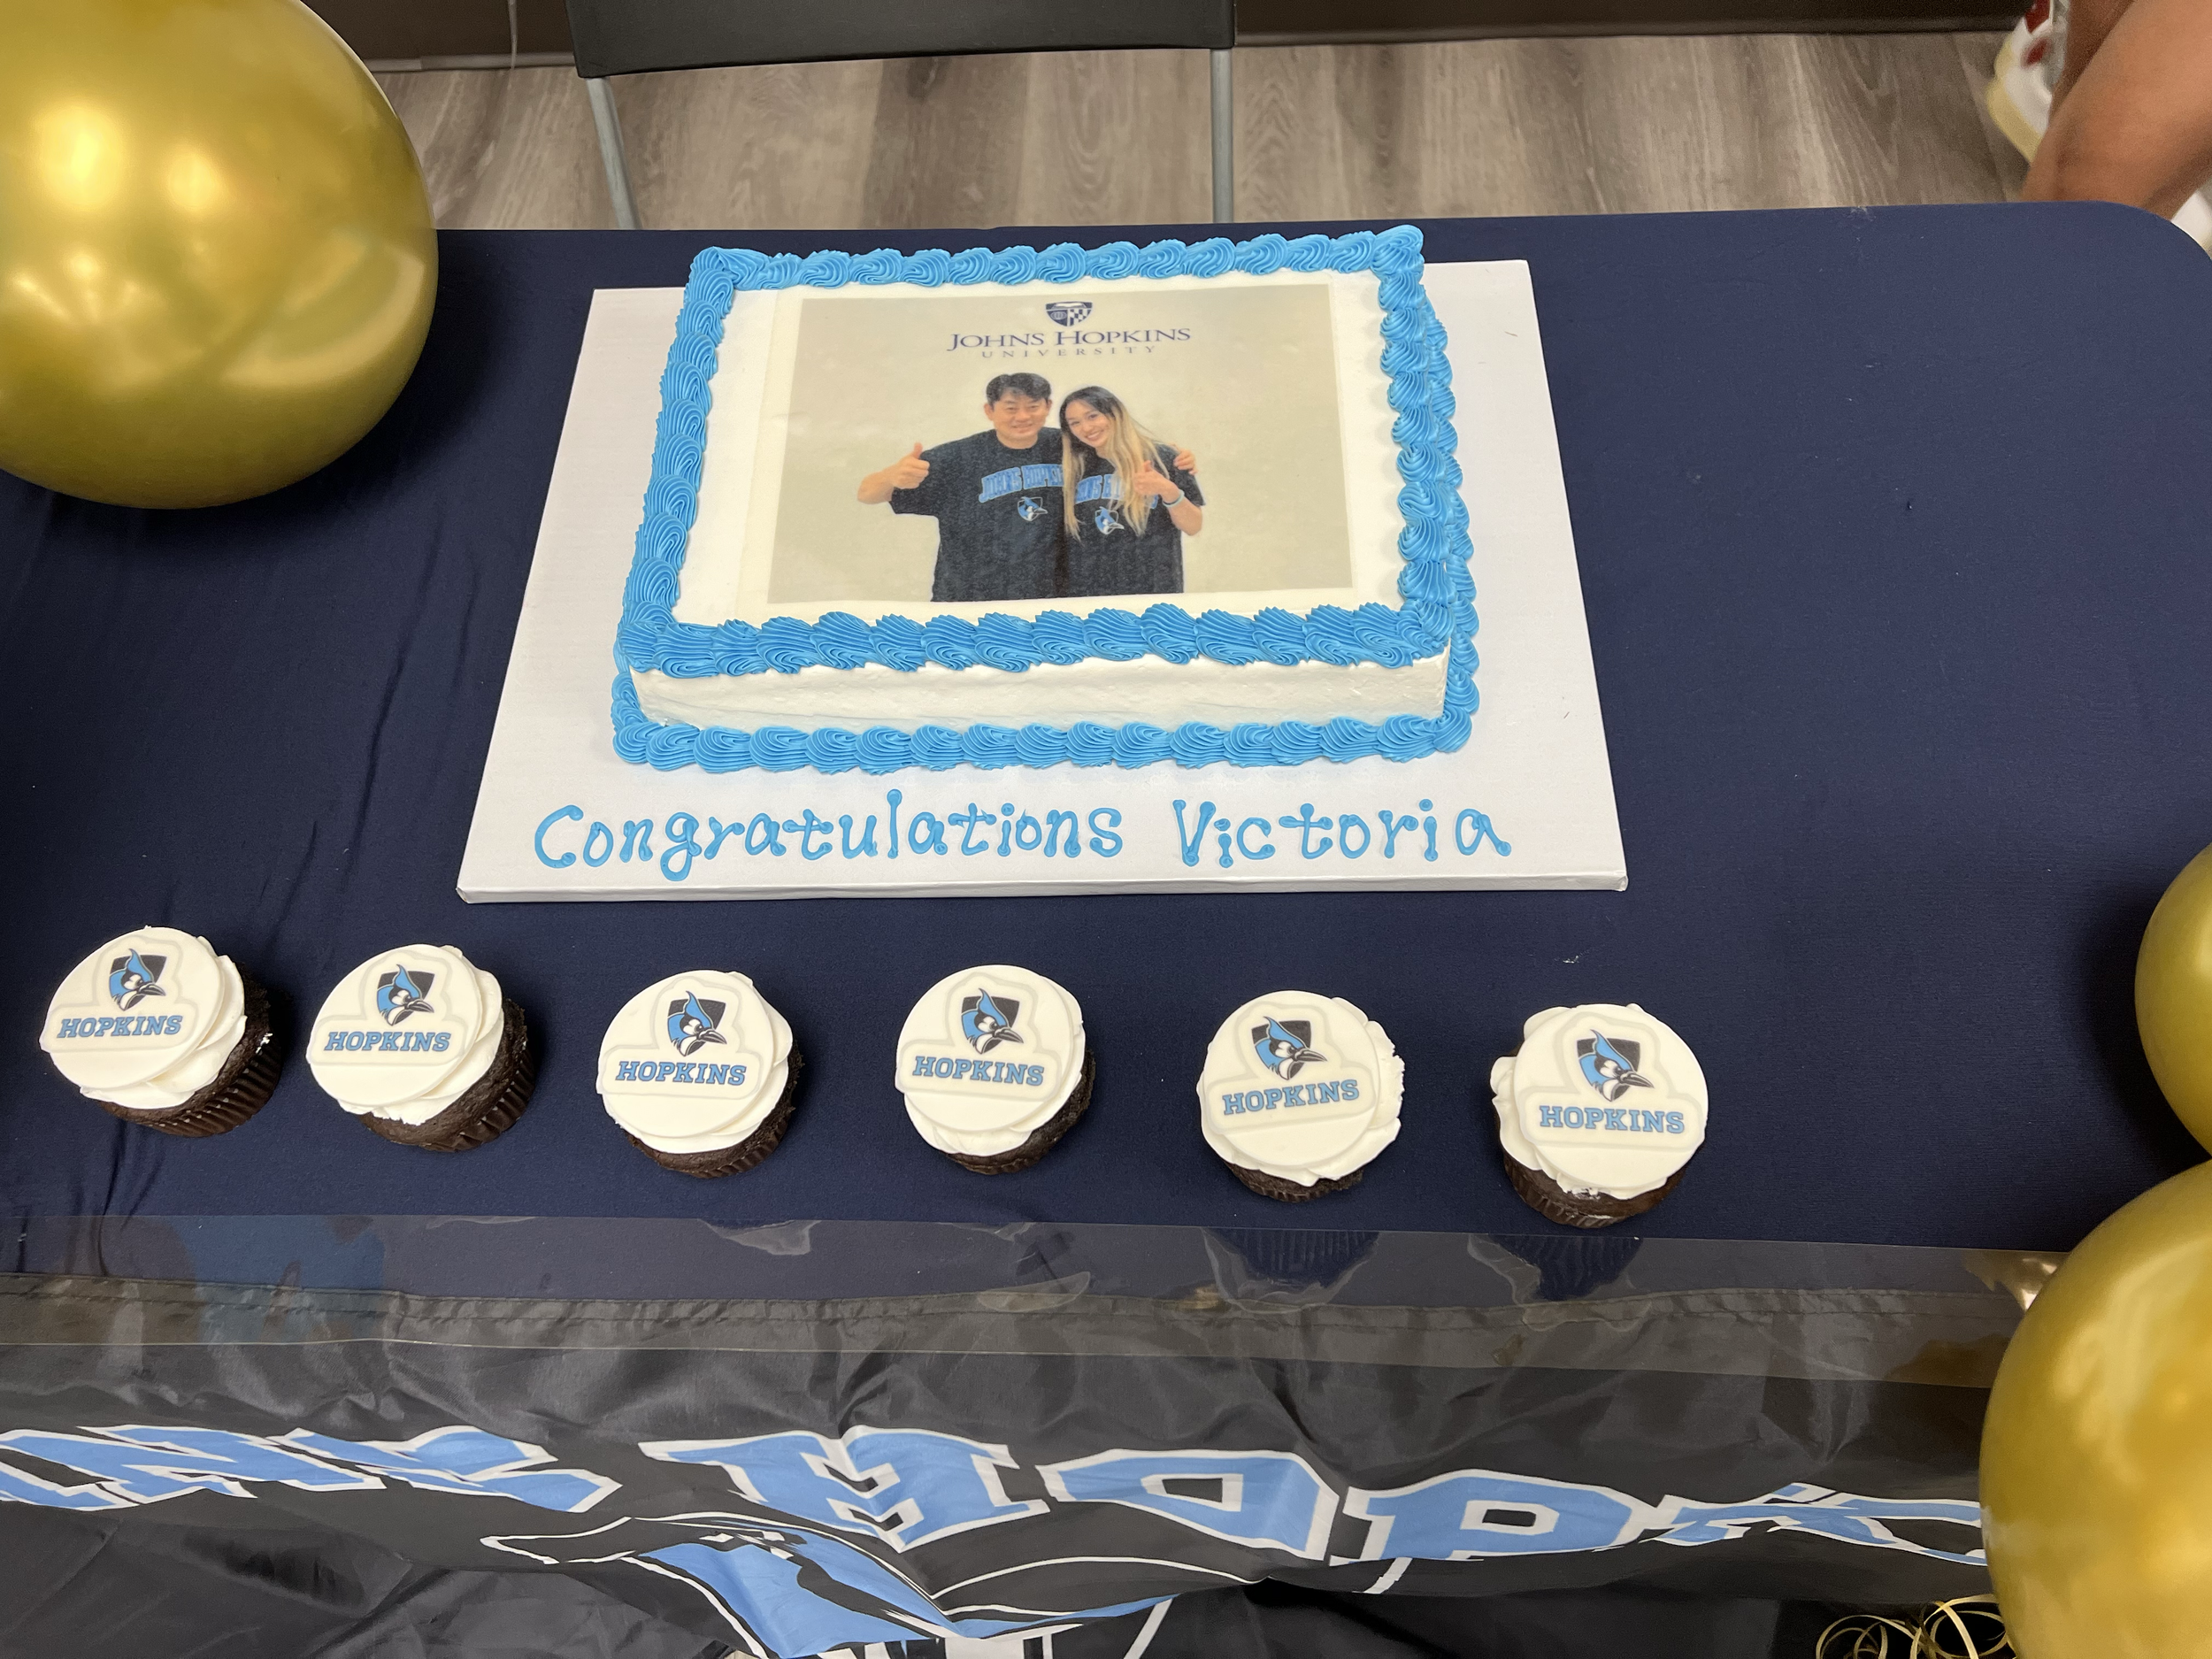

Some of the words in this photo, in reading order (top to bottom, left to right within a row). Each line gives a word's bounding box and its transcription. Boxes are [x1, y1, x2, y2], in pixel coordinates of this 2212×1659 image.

[947, 332, 1045, 351] JOHNS
[1055, 327, 1191, 346] HOPKINS
[982, 345, 1156, 358] UNIVERSITY
[534, 788, 1123, 882] Congratulations
[1172, 798, 1512, 868] Victoria
[57, 1014, 184, 1040] HOPKINS
[324, 1030, 452, 1053] HOPKINS
[615, 1059, 748, 1087] HOPKINS
[911, 1055, 1045, 1087] HOPKINS
[1222, 1079, 1360, 1117] HOPKINS
[1539, 1104, 1686, 1134] HOPKINS
